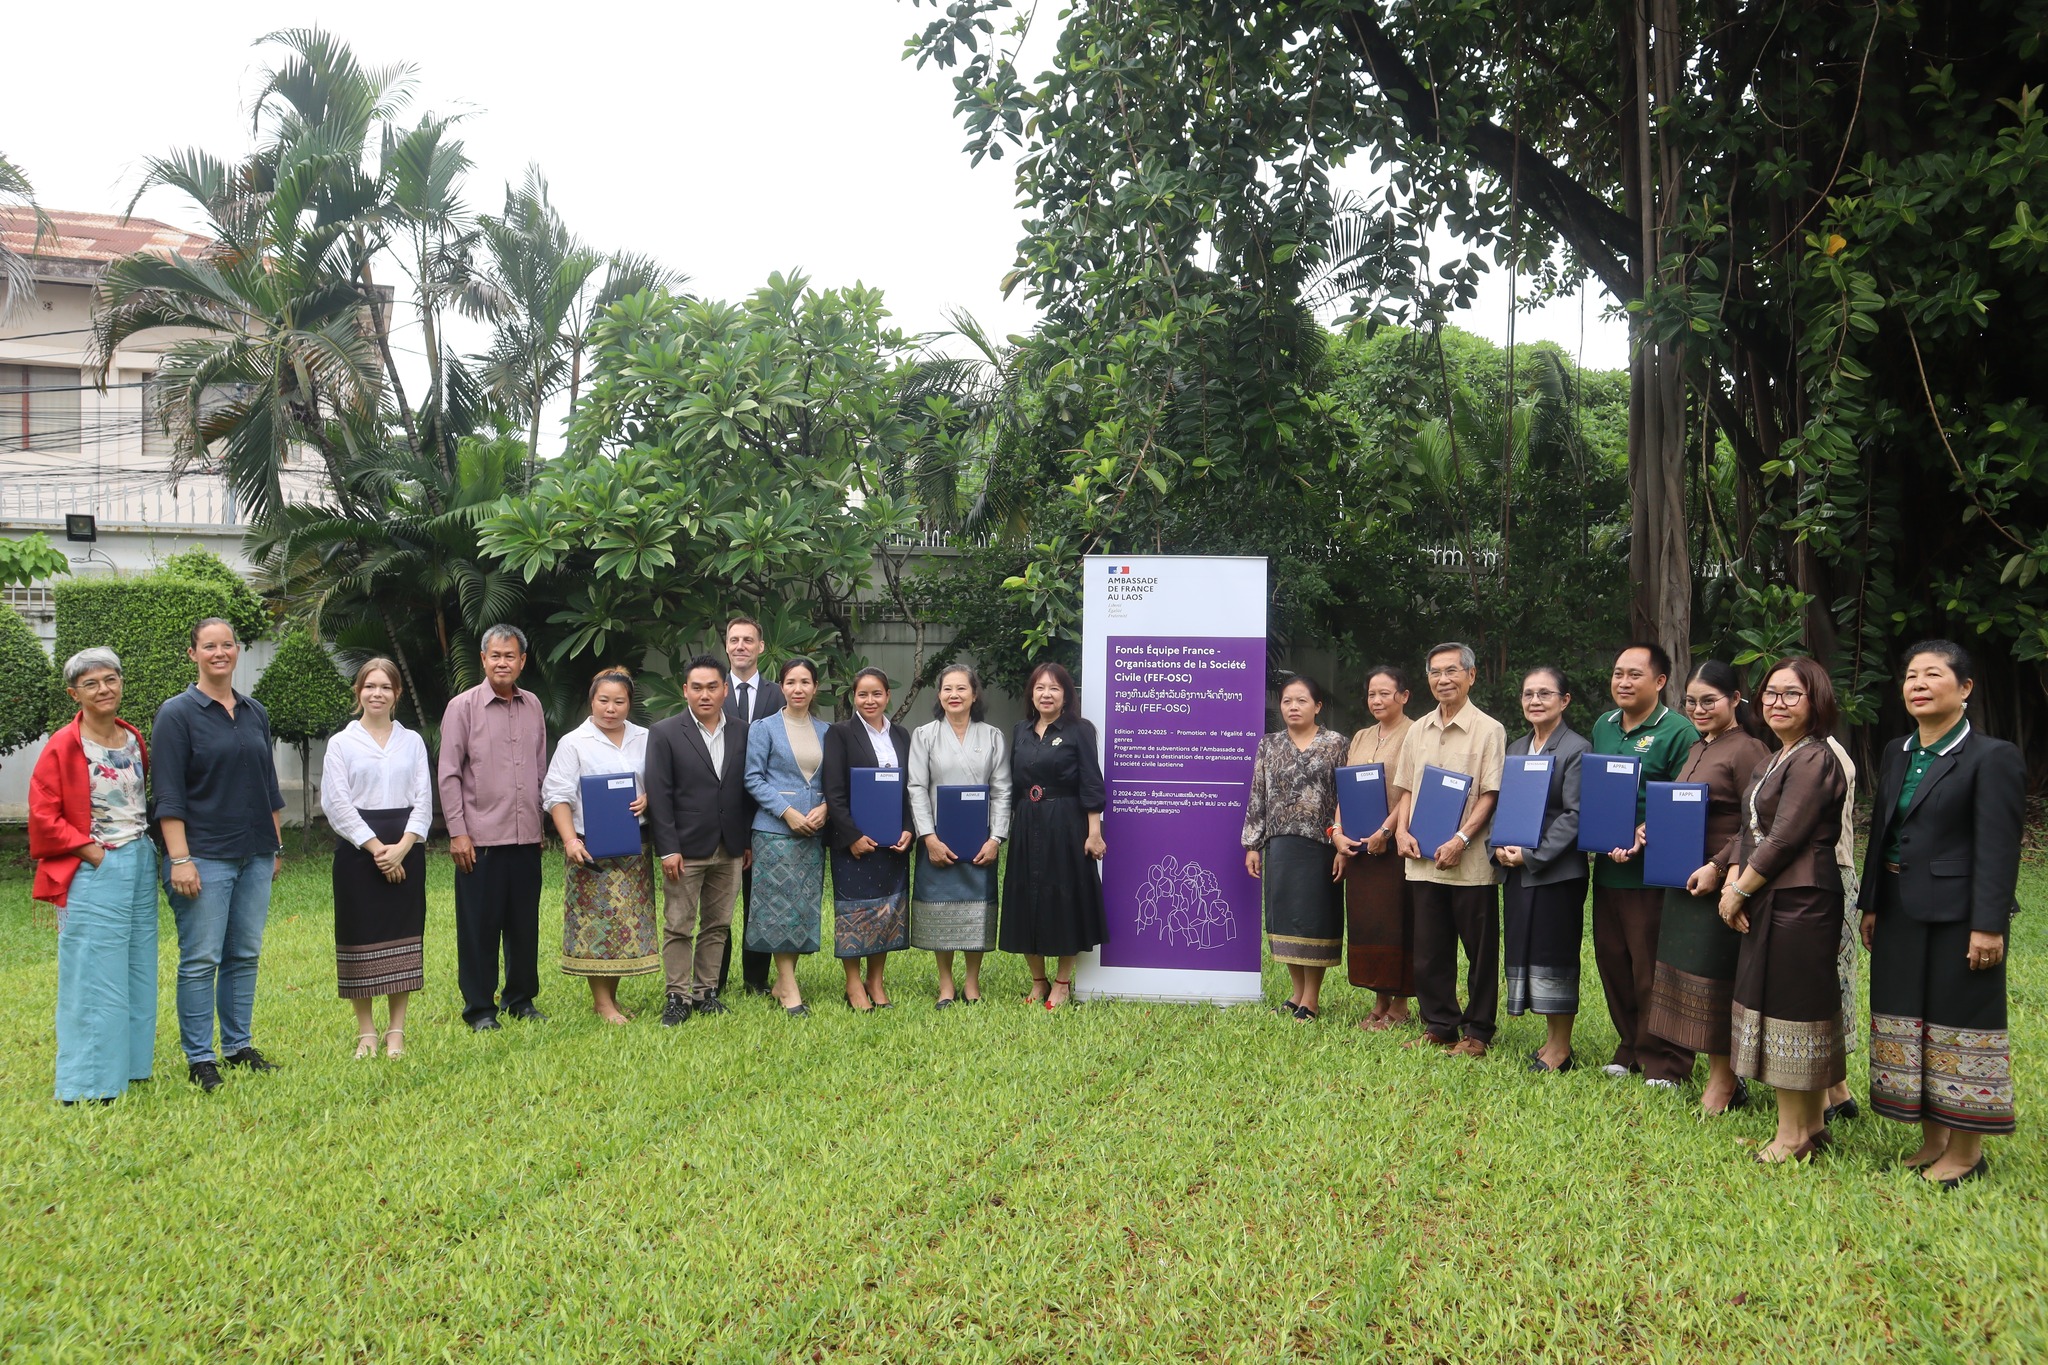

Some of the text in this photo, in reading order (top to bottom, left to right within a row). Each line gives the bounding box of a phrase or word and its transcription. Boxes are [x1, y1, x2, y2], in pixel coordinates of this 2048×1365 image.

[1115, 645, 1144, 654] Fonds
[1147, 644, 1179, 656] Équipe
[1183, 646, 1215, 655] France
[1115, 660, 1246, 670] Organisations de la Société
[1115, 673, 1192, 684] Civile (FEF-OSC)
[1140, 704, 1190, 714] (FEF-OSC)
